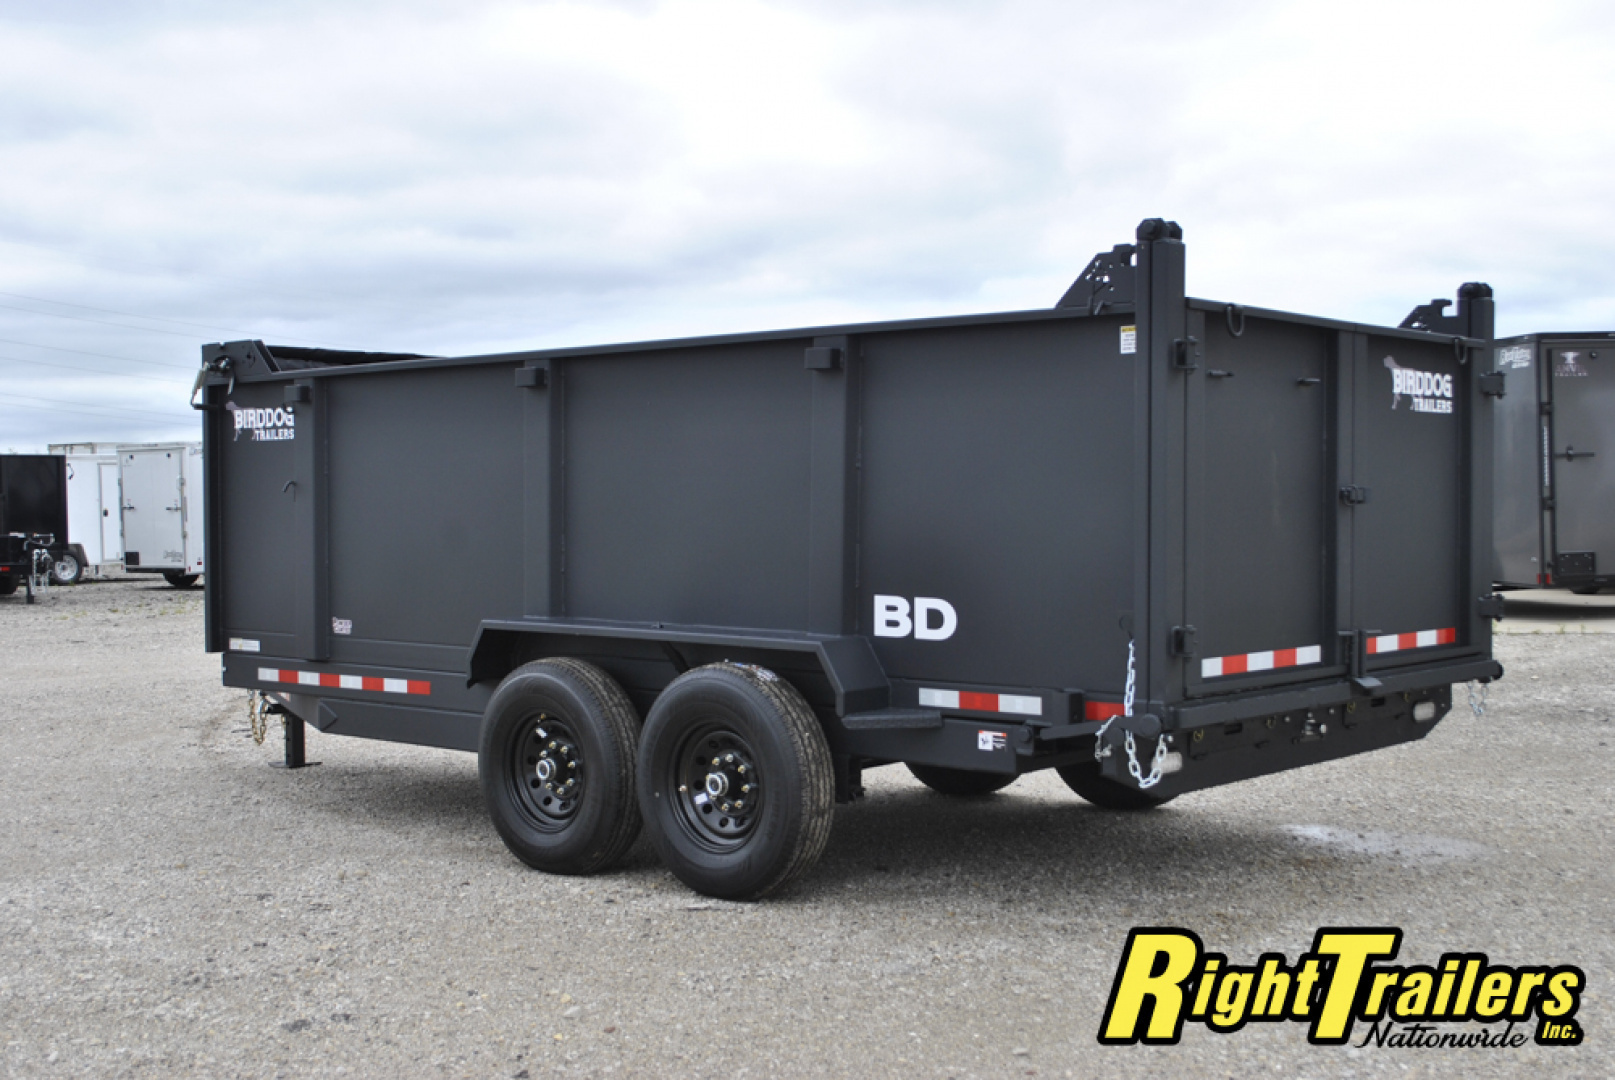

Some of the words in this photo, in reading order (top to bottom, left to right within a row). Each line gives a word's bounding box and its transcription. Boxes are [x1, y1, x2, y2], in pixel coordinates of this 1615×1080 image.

[1392, 369, 1453, 398] BIRDDOG
[1413, 398, 1453, 414] TRAILERS
[234, 407, 295, 428] BIRDDOG
[255, 429, 295, 441] TRAILERS
[873, 594, 957, 641] BD
